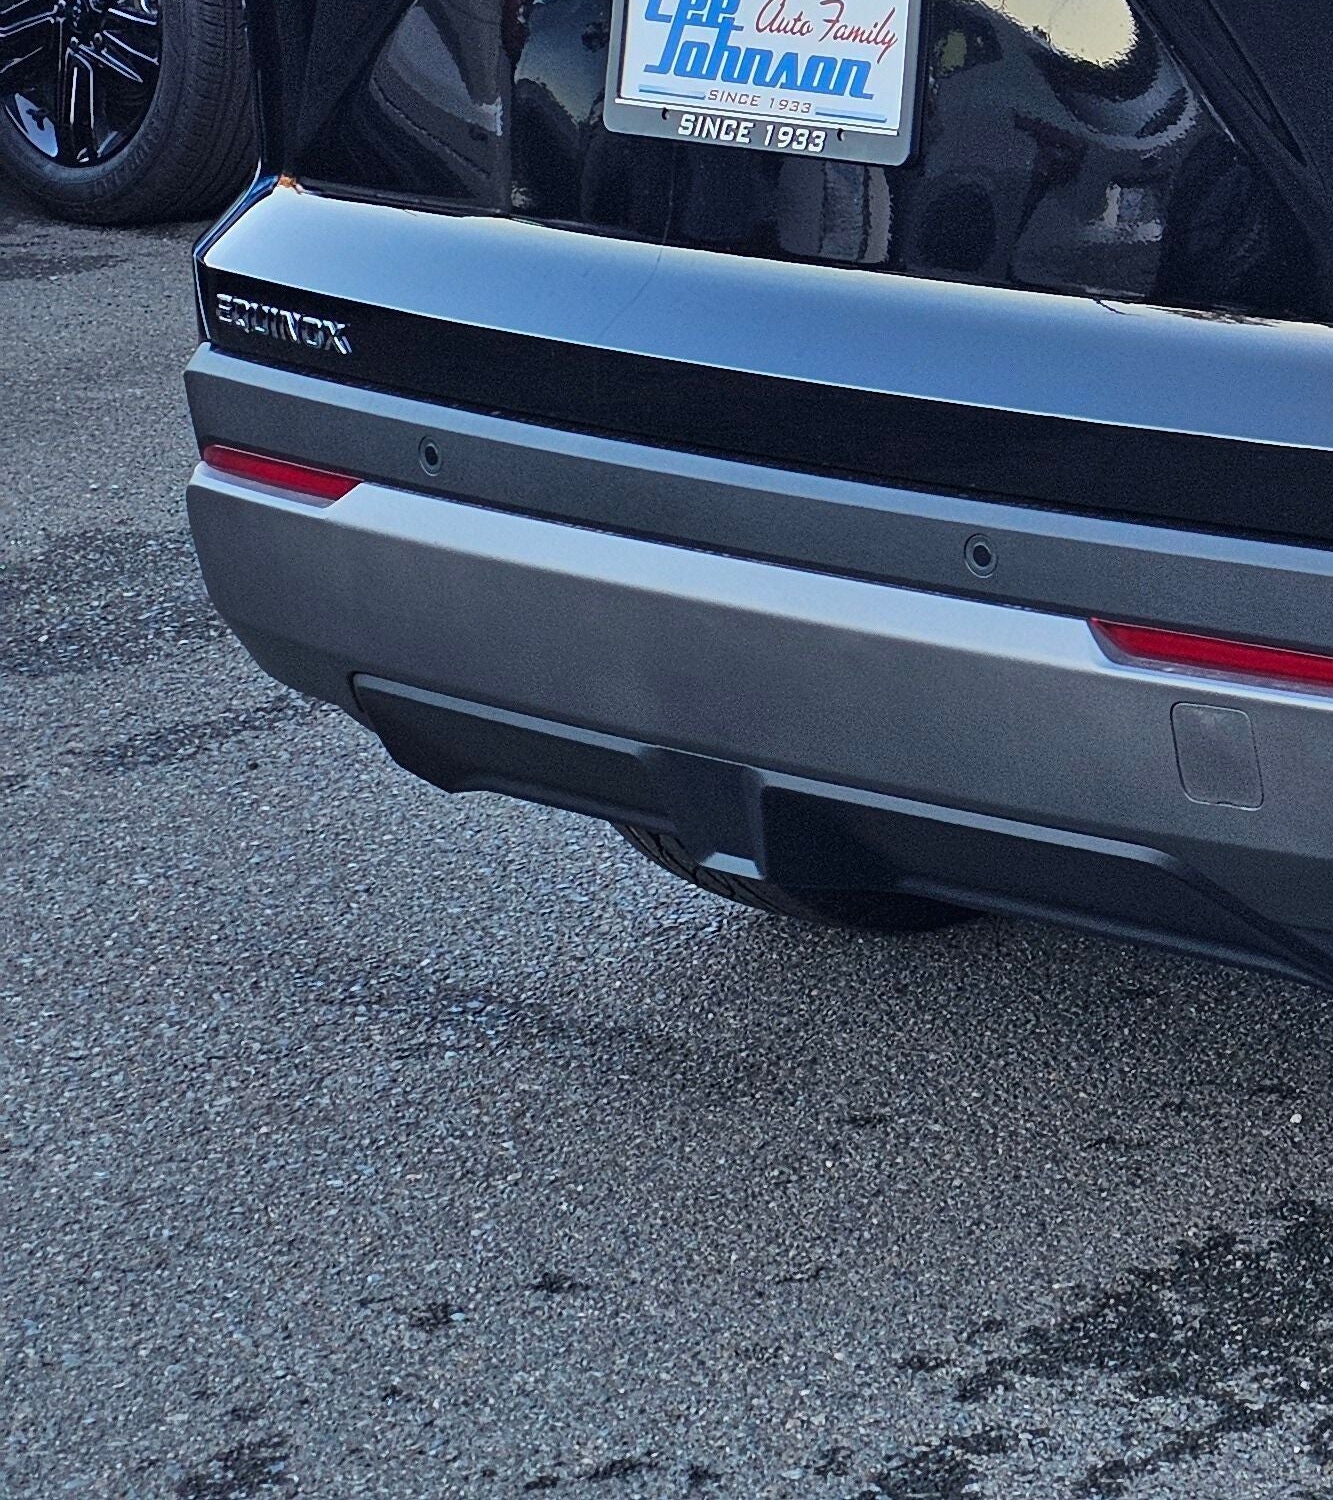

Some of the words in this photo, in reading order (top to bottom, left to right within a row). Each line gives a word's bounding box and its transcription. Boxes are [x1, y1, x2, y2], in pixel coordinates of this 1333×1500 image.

[643, 18, 874, 99] Johnson
[818, 0, 898, 63] Family
[708, 90, 760, 107] SINCE
[769, 97, 812, 114] 1933
[678, 114, 753, 143] SINCE
[764, 124, 826, 153] 1933
[215, 294, 352, 355] EQUINOX
